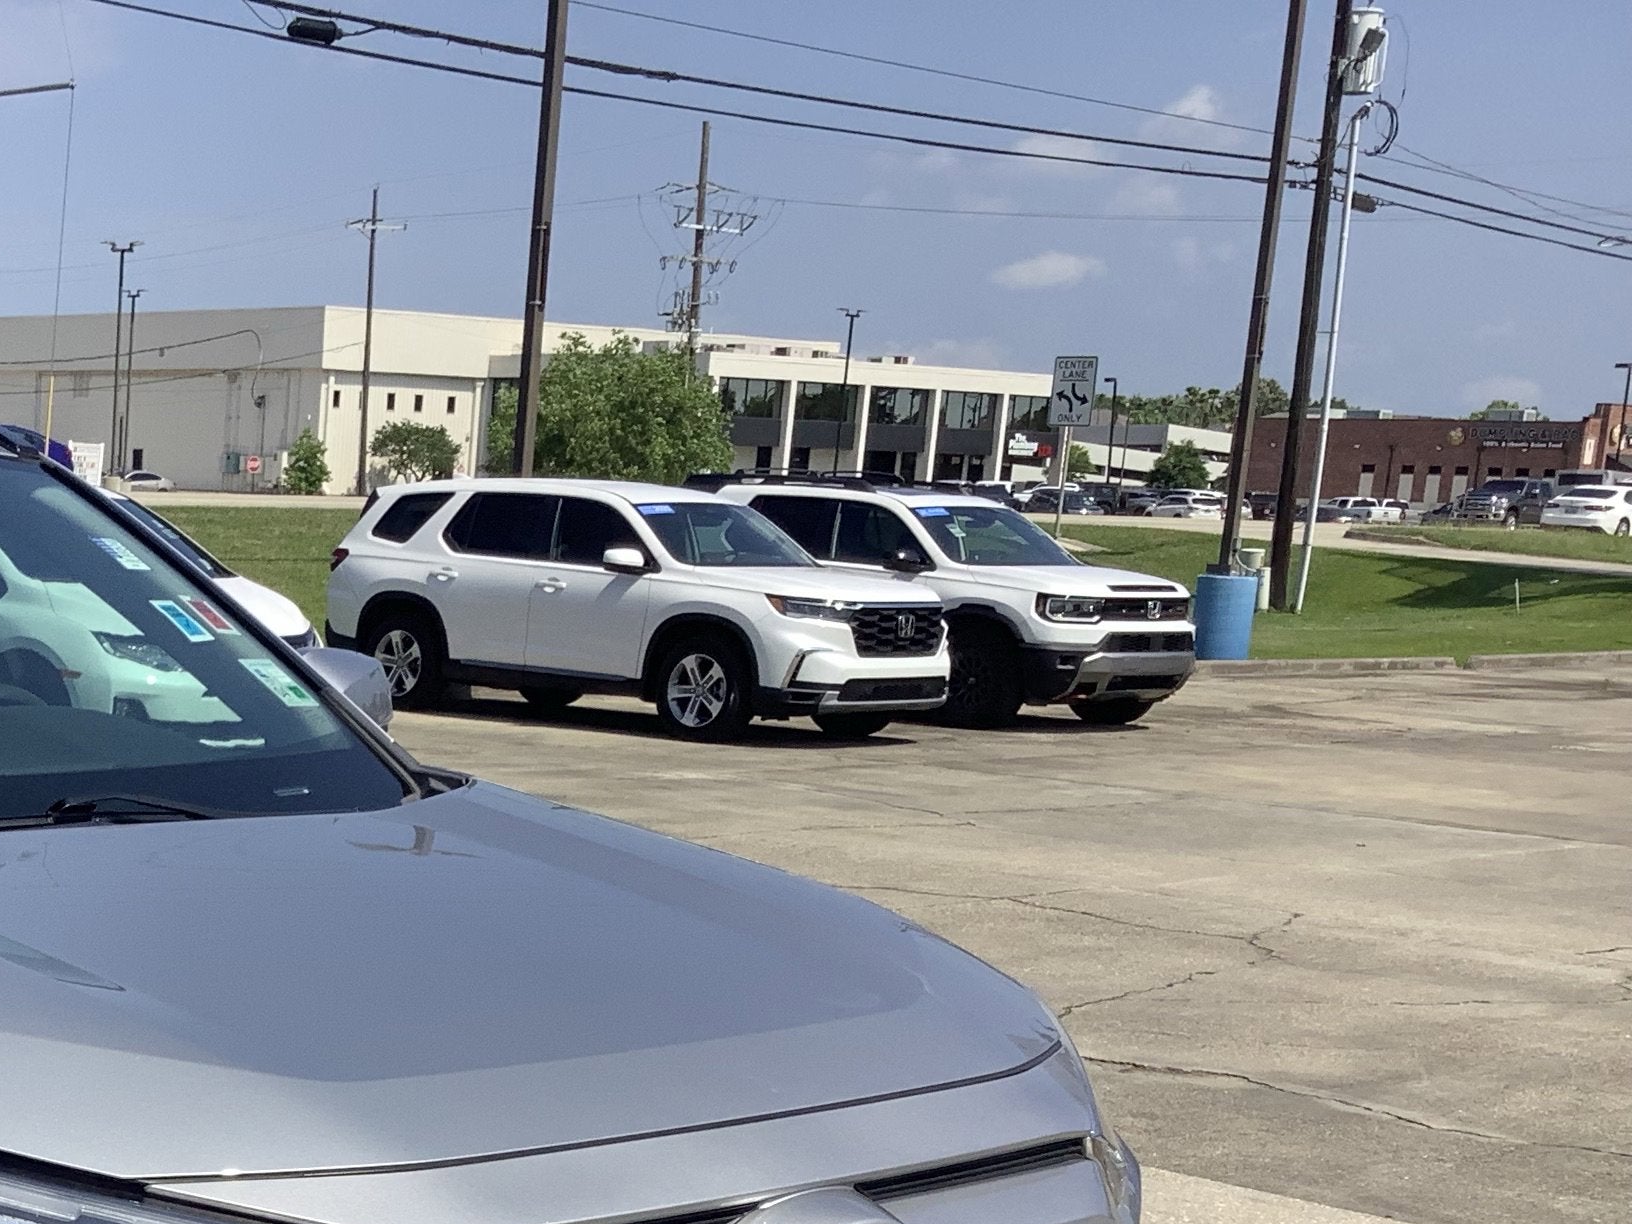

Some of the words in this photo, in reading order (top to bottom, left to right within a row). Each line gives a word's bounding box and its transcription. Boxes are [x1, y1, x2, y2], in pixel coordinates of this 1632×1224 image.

[1059, 360, 1094, 369] CENTER
[1063, 370, 1087, 378] LANE
[1058, 413, 1083, 423] ONLY
